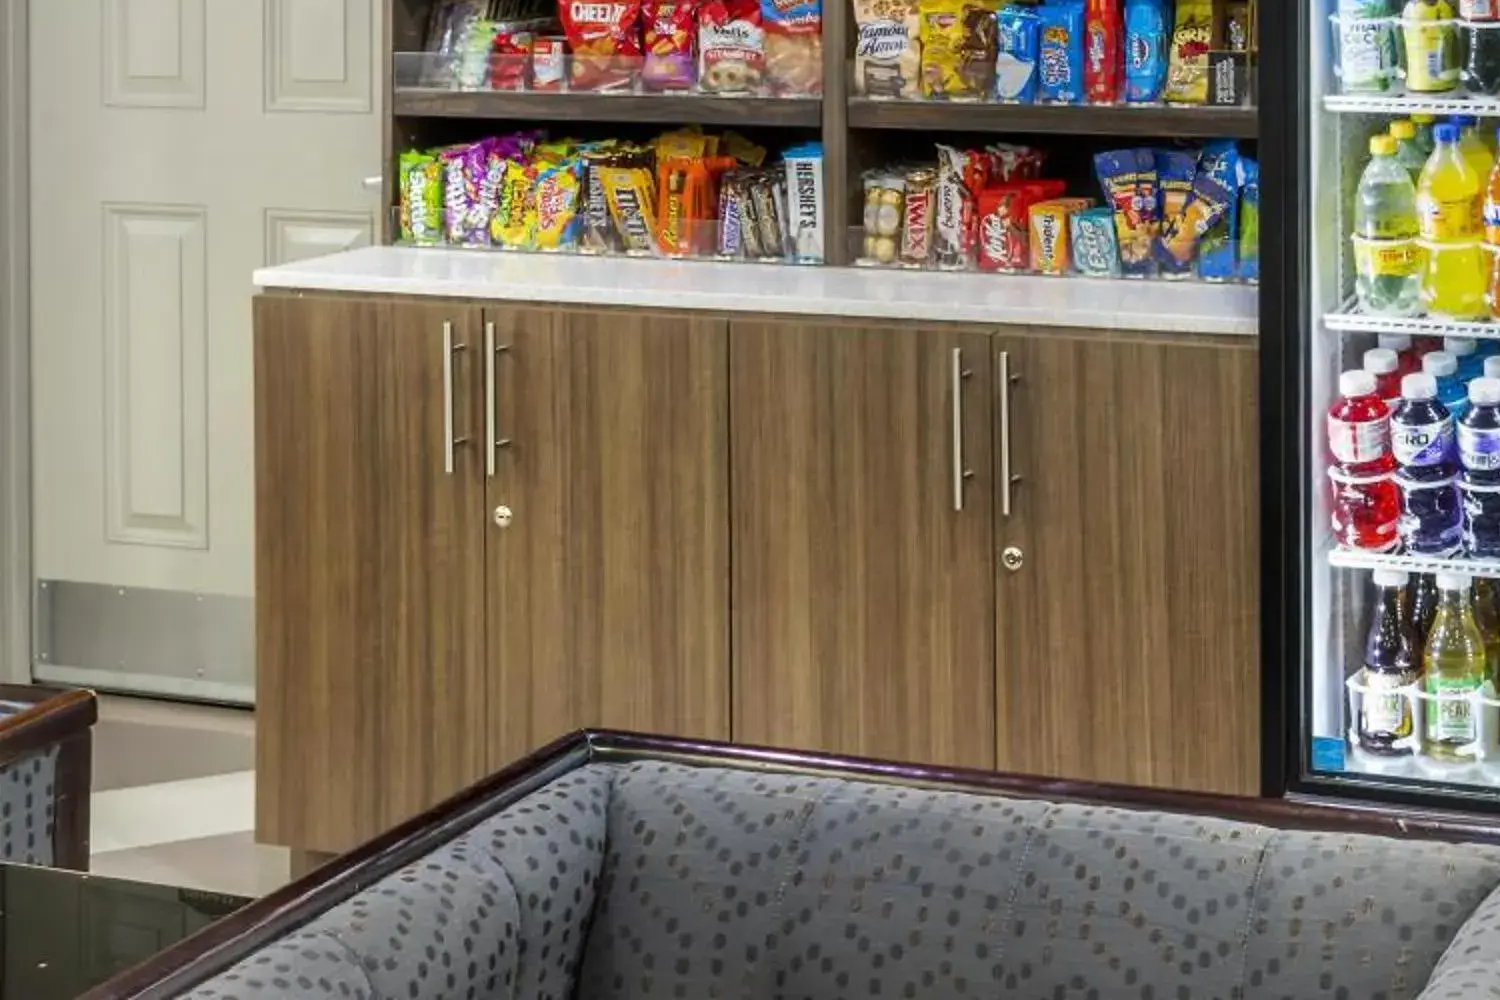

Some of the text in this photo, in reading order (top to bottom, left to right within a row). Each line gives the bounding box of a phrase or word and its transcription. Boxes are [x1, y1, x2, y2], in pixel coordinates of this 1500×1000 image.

[796, 161, 817, 229] HERSHEY'S
[906, 193, 928, 251] TWIX
[1043, 214, 1054, 261] Trident
[1440, 701, 1472, 717] PEAK
